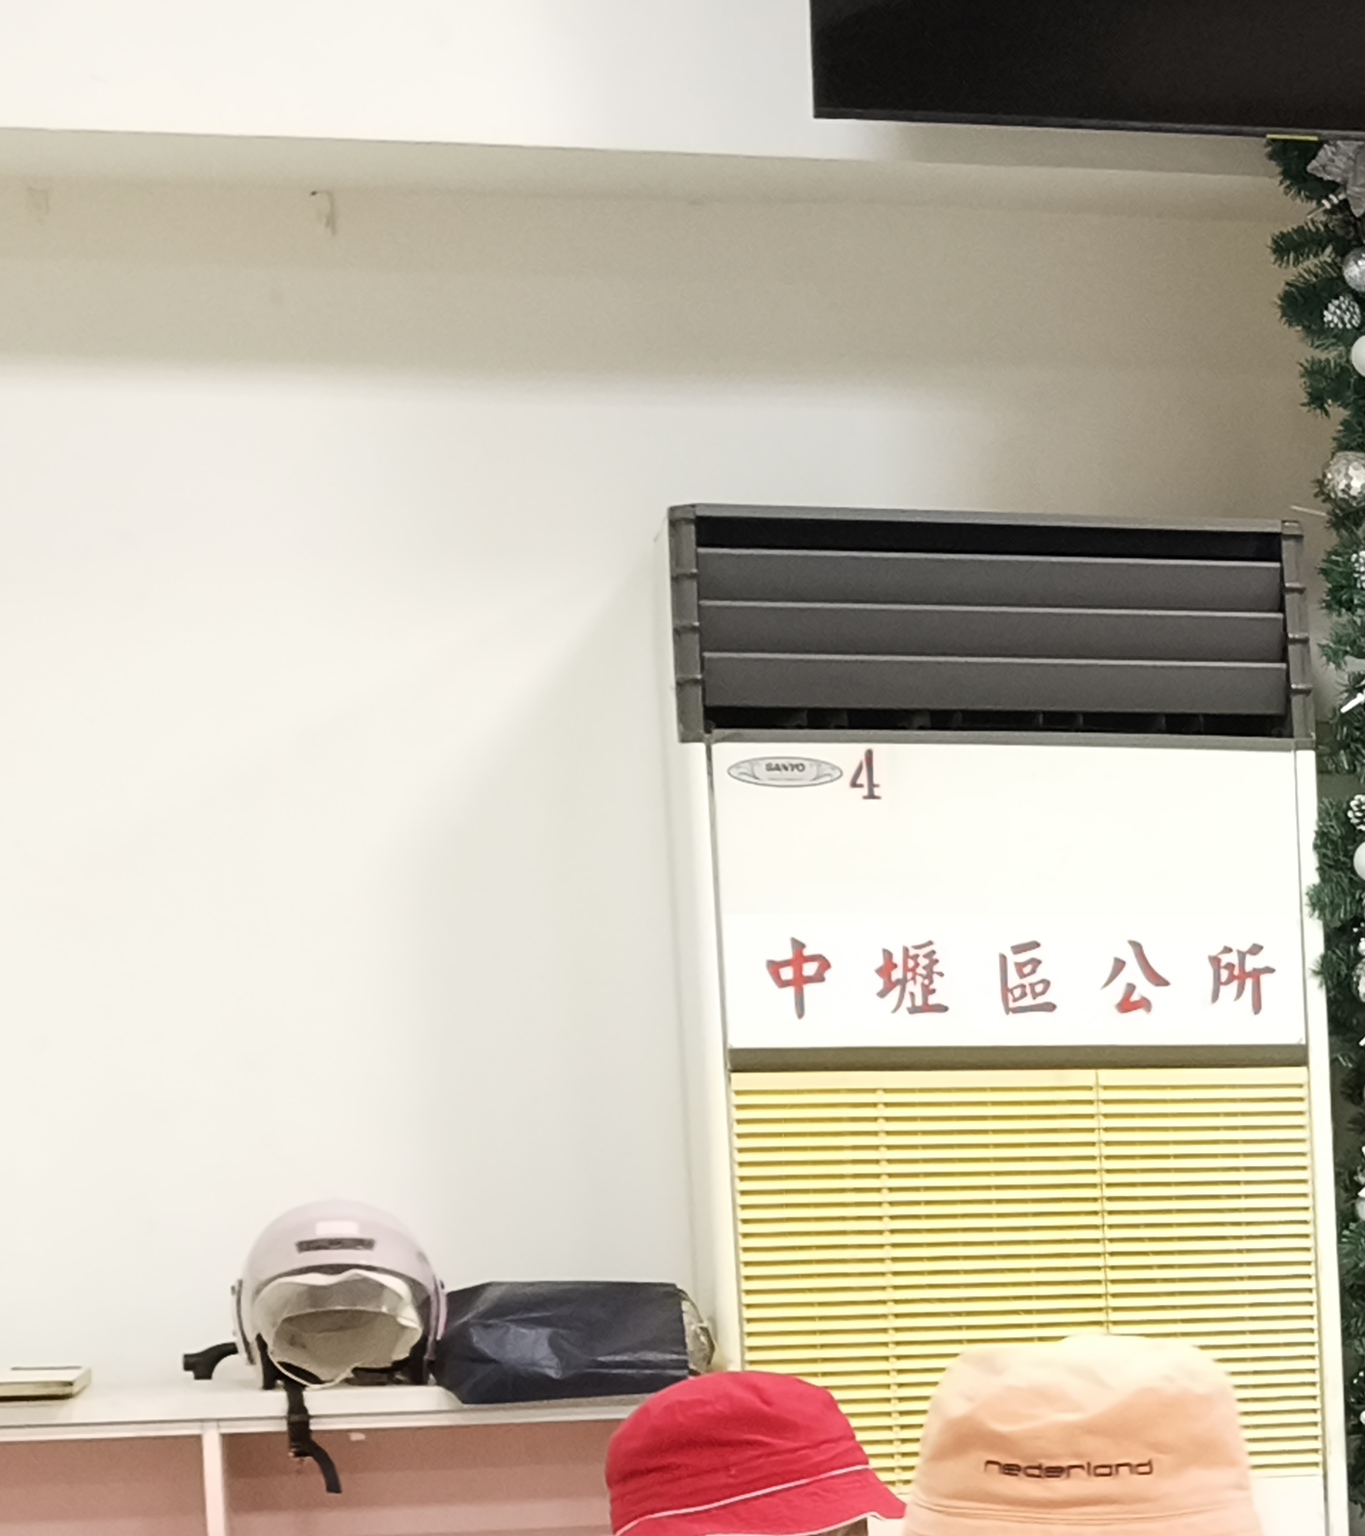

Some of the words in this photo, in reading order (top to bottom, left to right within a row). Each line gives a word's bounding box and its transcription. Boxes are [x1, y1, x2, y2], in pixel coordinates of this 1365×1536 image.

[765, 762, 806, 773] SANYO
[849, 748, 882, 800] 4
[765, 936, 1276, 1020] 中壢區公所
